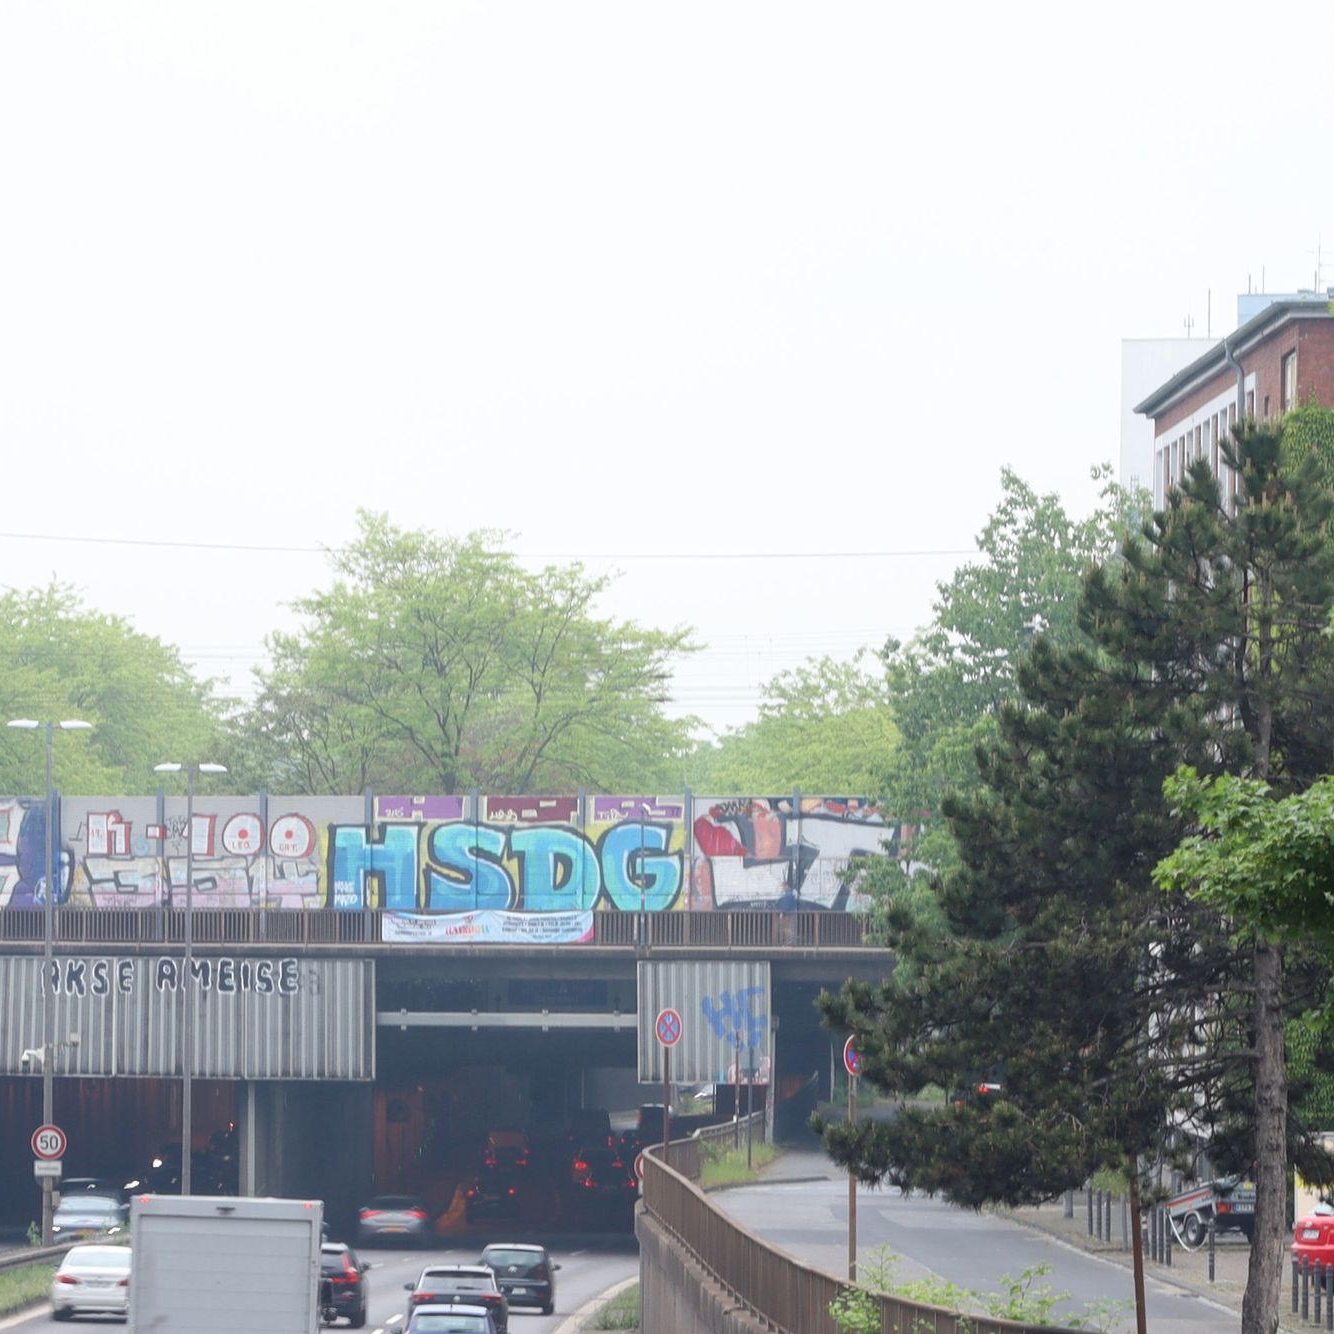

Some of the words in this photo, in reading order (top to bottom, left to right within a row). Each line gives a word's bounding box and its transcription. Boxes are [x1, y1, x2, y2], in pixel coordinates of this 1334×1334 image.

[327, 820, 684, 911] HSDG
[155, 956, 299, 996] AMEISE
[40, 1135, 58, 1150] 50
